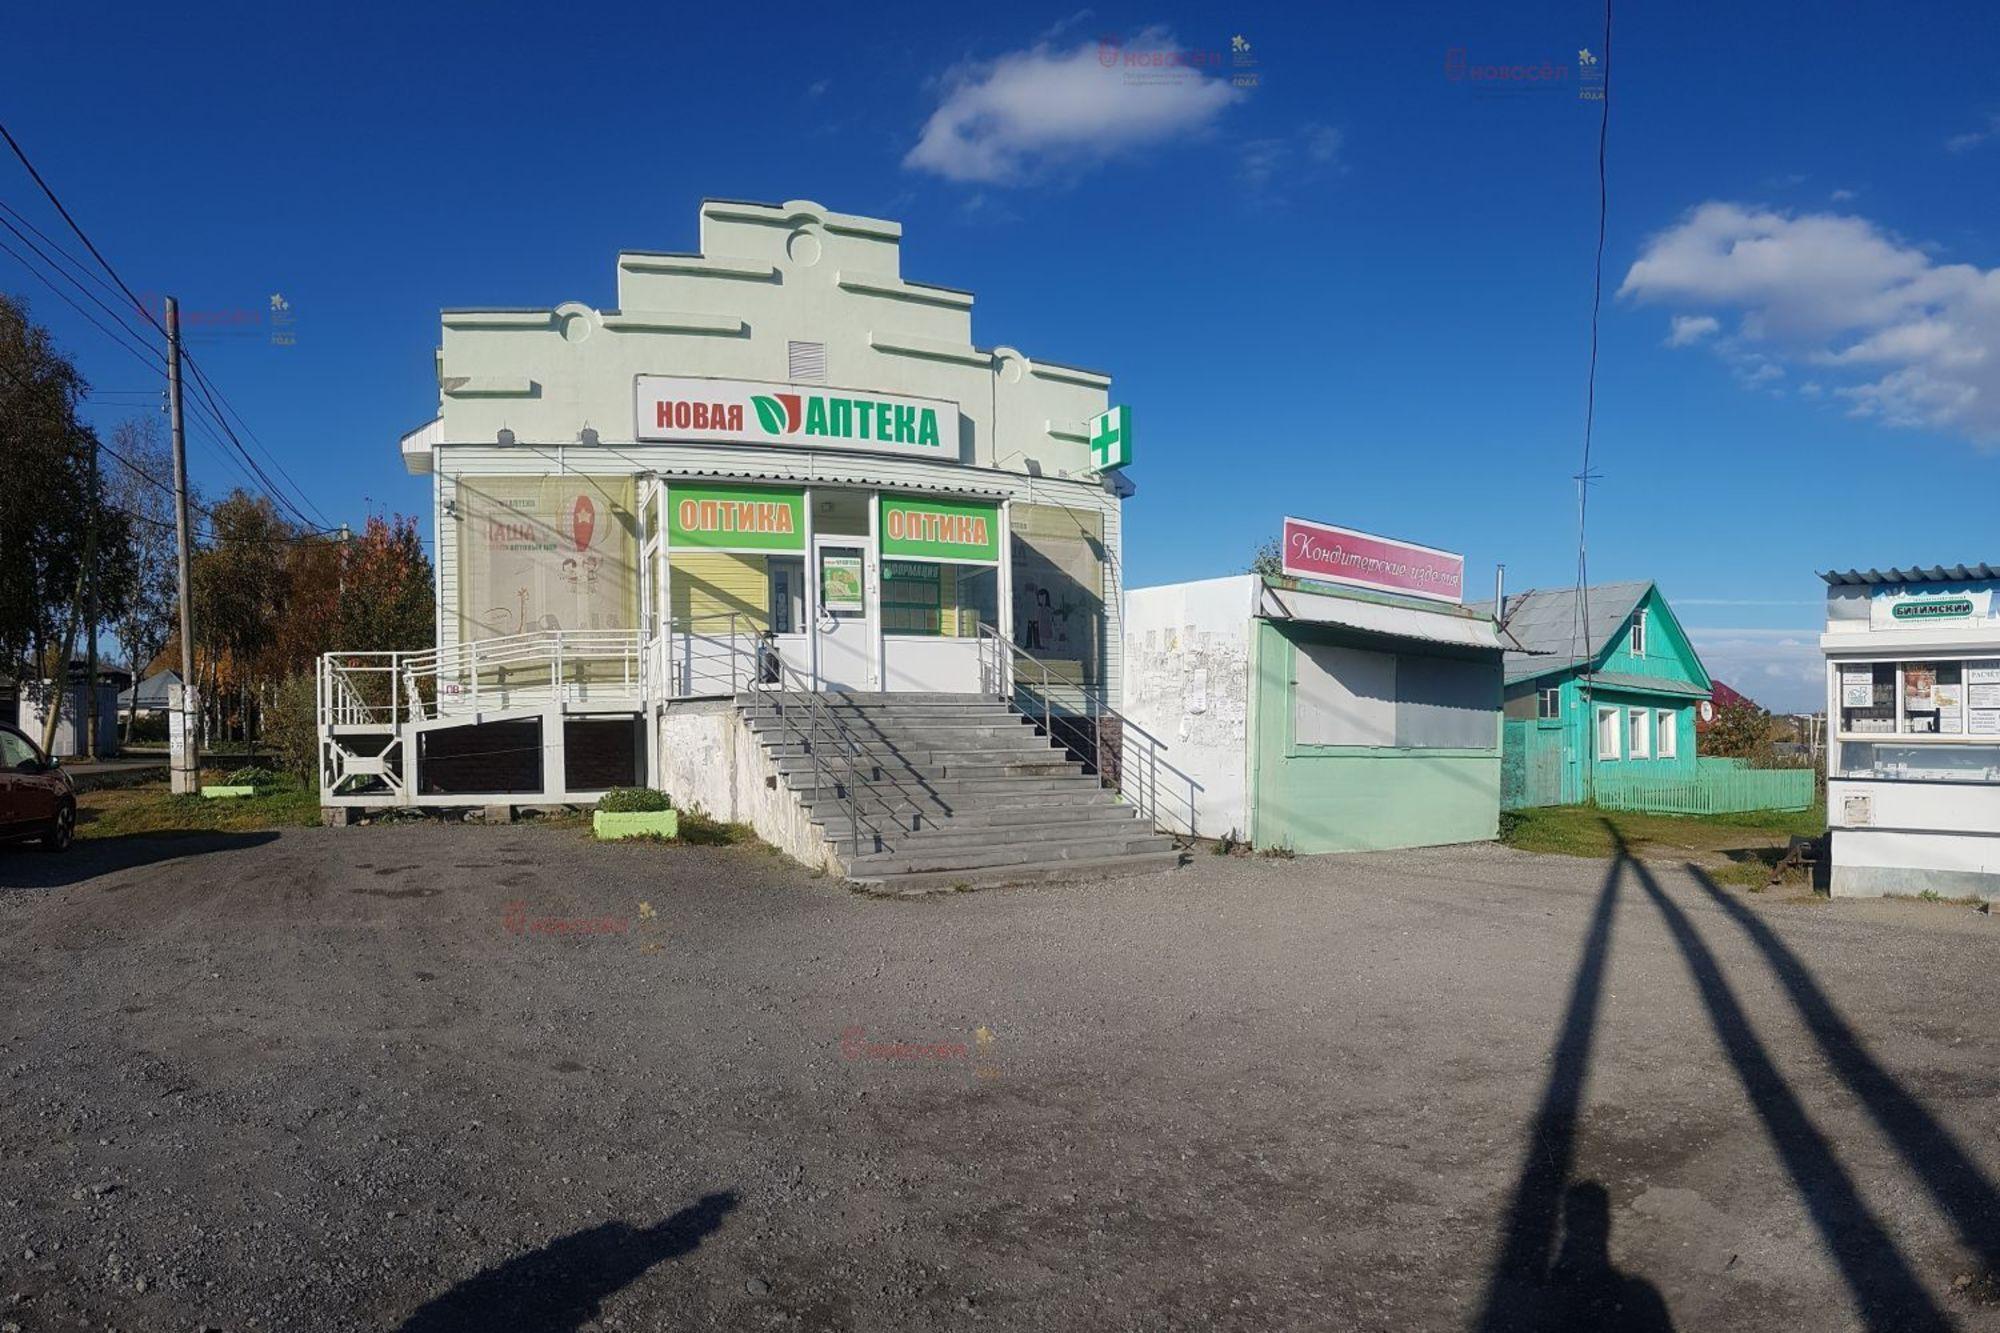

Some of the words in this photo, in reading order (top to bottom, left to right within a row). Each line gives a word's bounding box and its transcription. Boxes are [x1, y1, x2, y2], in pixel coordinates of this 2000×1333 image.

[656, 400, 743, 431] НОВАЯ
[805, 395, 940, 446] АПТЕКА
[679, 499, 794, 533] ОПТИКА
[887, 509, 989, 546] ОПТИКА
[1292, 532, 1407, 576] Кондитерские
[1409, 562, 1459, 587] изделия
